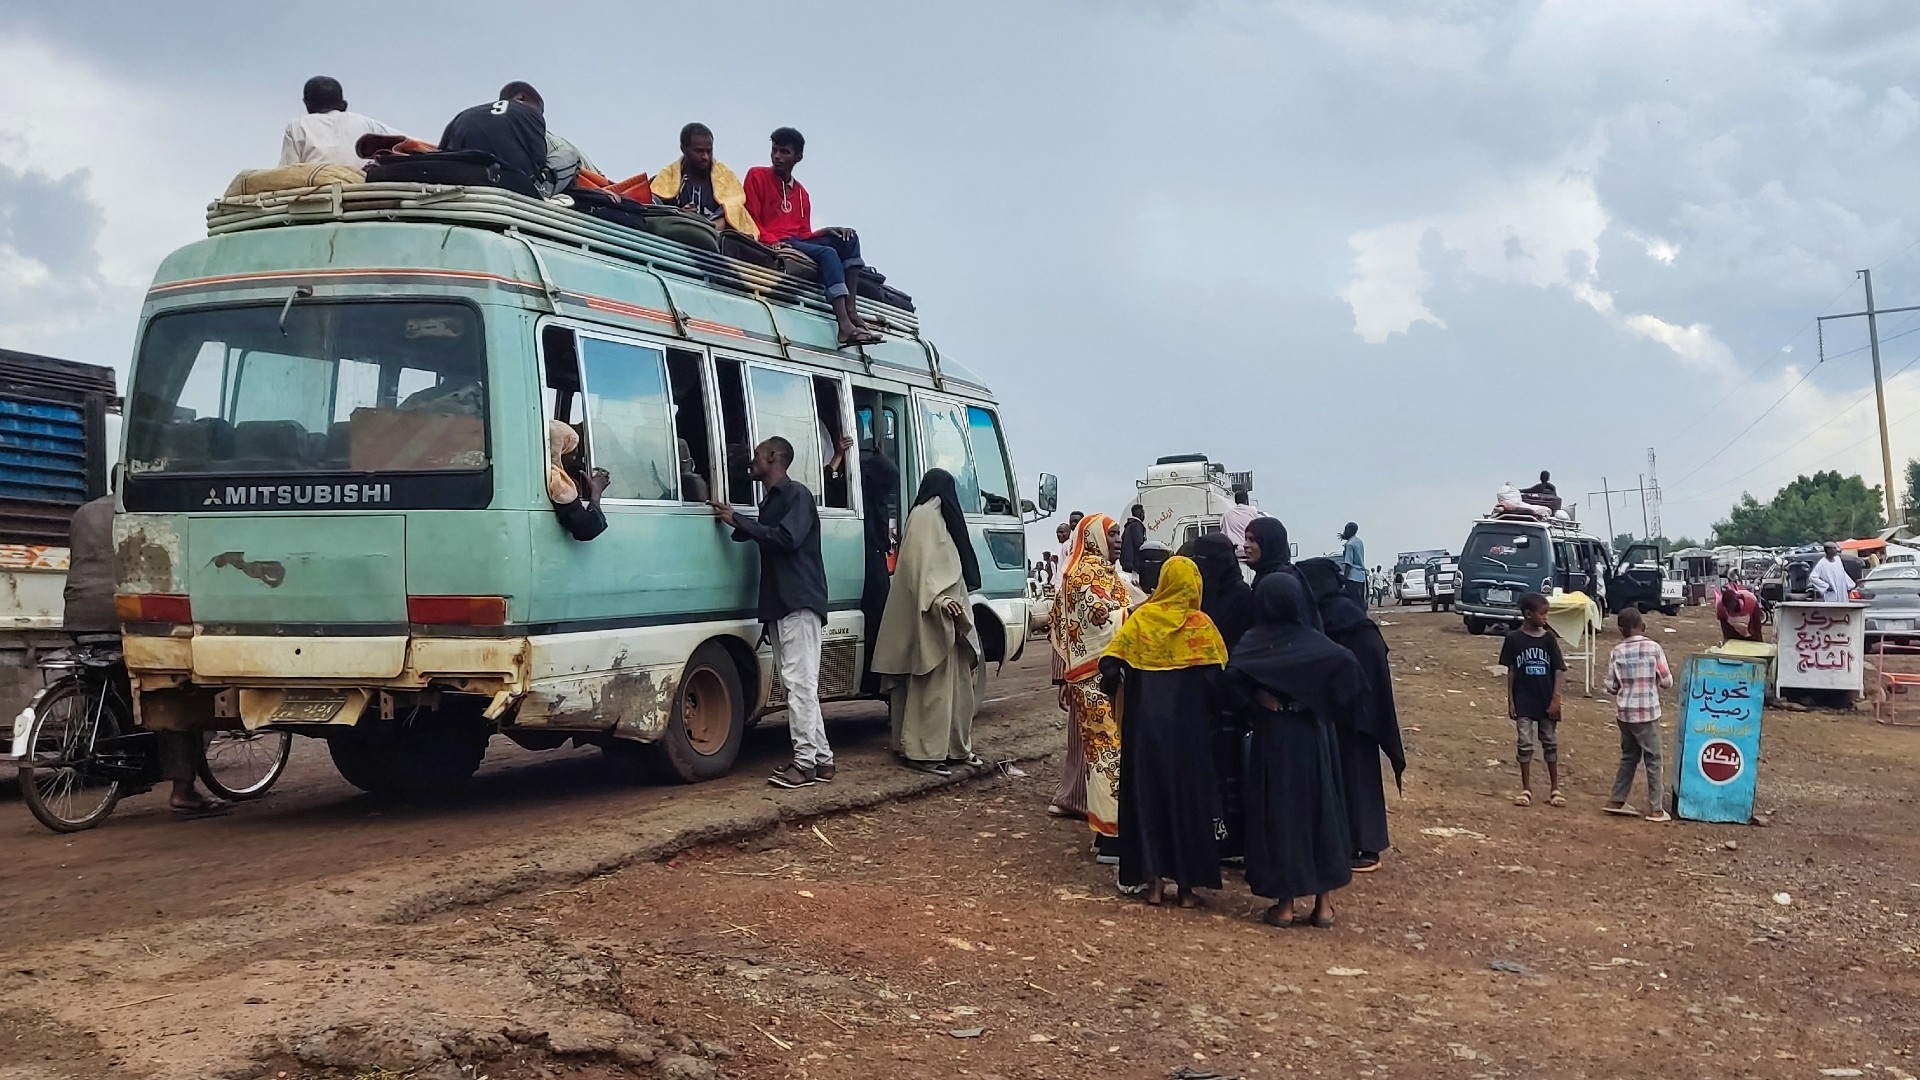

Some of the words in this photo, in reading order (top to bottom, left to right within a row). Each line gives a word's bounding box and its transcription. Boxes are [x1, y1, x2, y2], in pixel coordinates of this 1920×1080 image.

[490, 100, 509, 115] 9
[225, 484, 391, 505] MITSUBISHI
[1794, 610, 1850, 630] مركز
[1796, 631, 1851, 650] توزيع
[1797, 650, 1854, 673] الثلج
[1692, 678, 1750, 703] تحويل
[1703, 747, 1739, 769] بنكك
